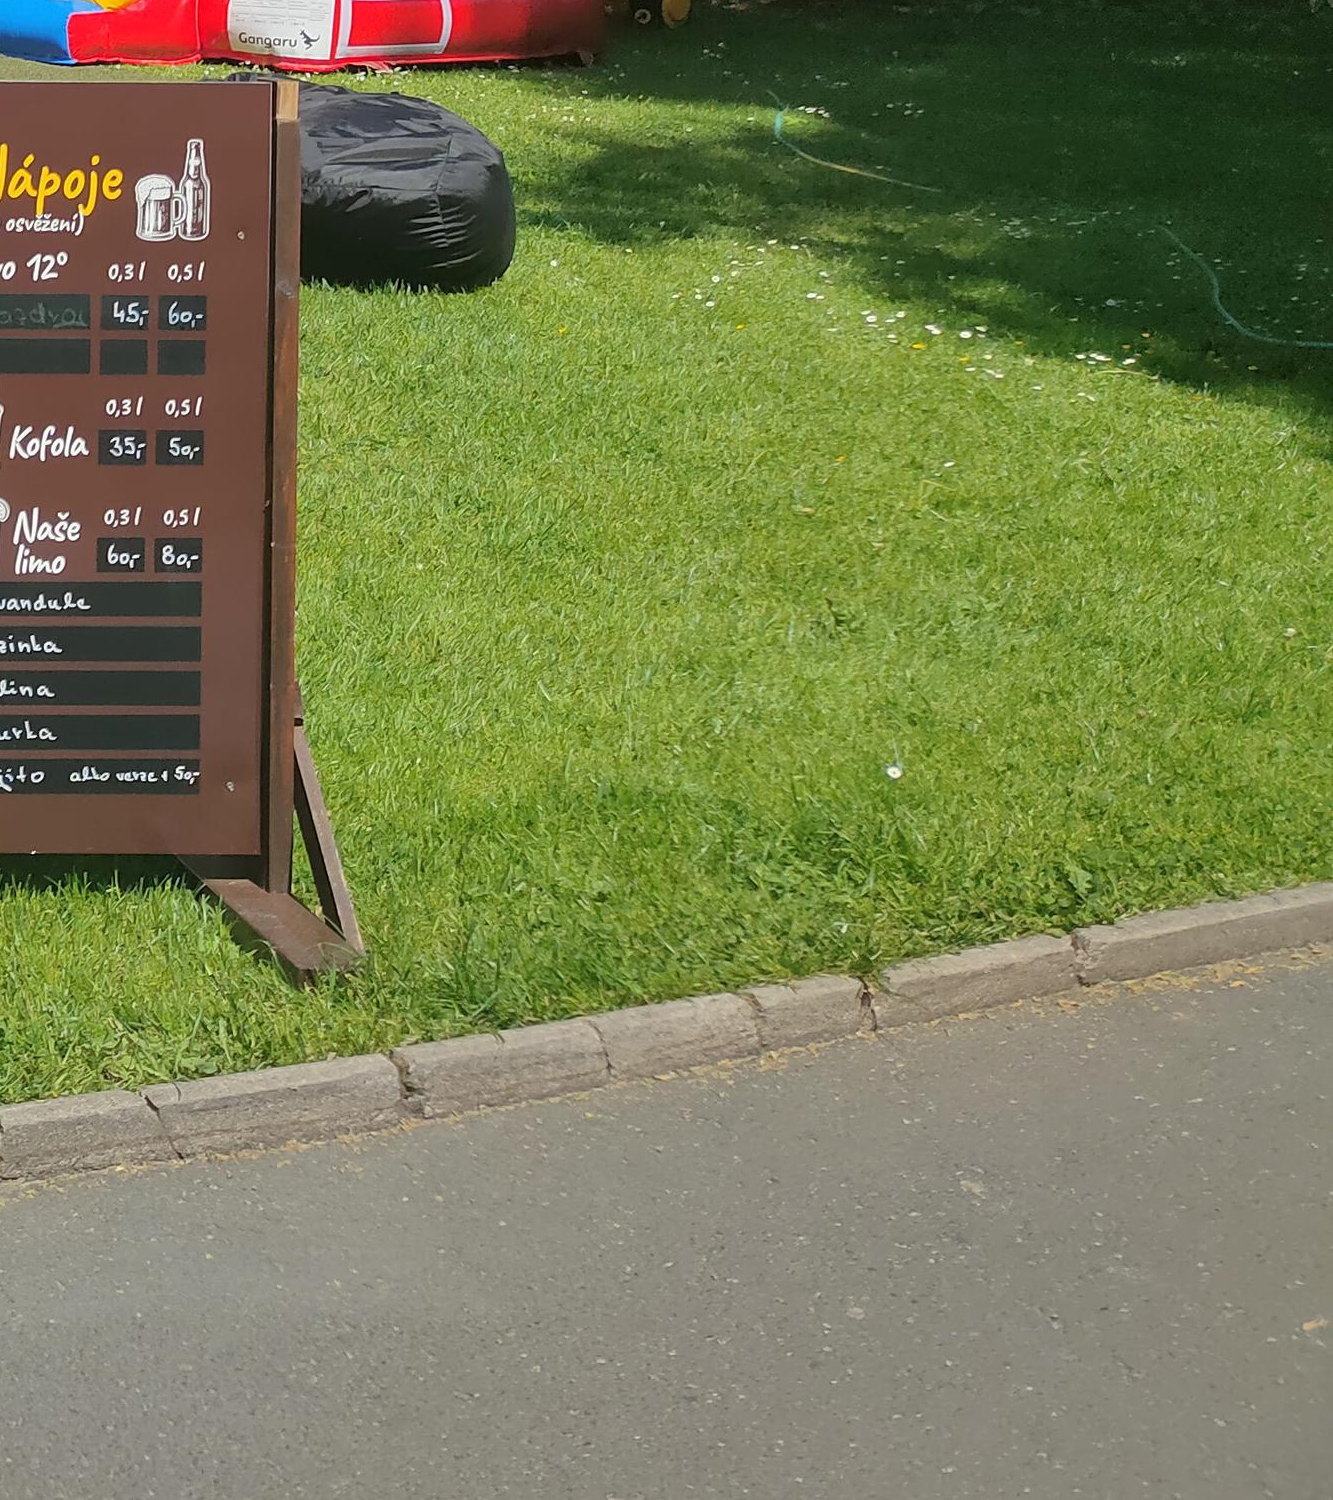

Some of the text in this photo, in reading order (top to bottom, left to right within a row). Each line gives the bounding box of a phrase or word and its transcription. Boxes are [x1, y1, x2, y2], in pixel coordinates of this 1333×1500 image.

[238, 31, 297, 49] Gangaru
[6, 209, 83, 236] osvěžení)
[114, 302, 148, 325] 45,-
[169, 302, 203, 327] 60,-
[10, 425, 89, 461] Kofola
[110, 437, 146, 459] 35,-
[13, 507, 80, 545] Naše
[15, 544, 66, 574] limo
[162, 545, 198, 568] 80,-
